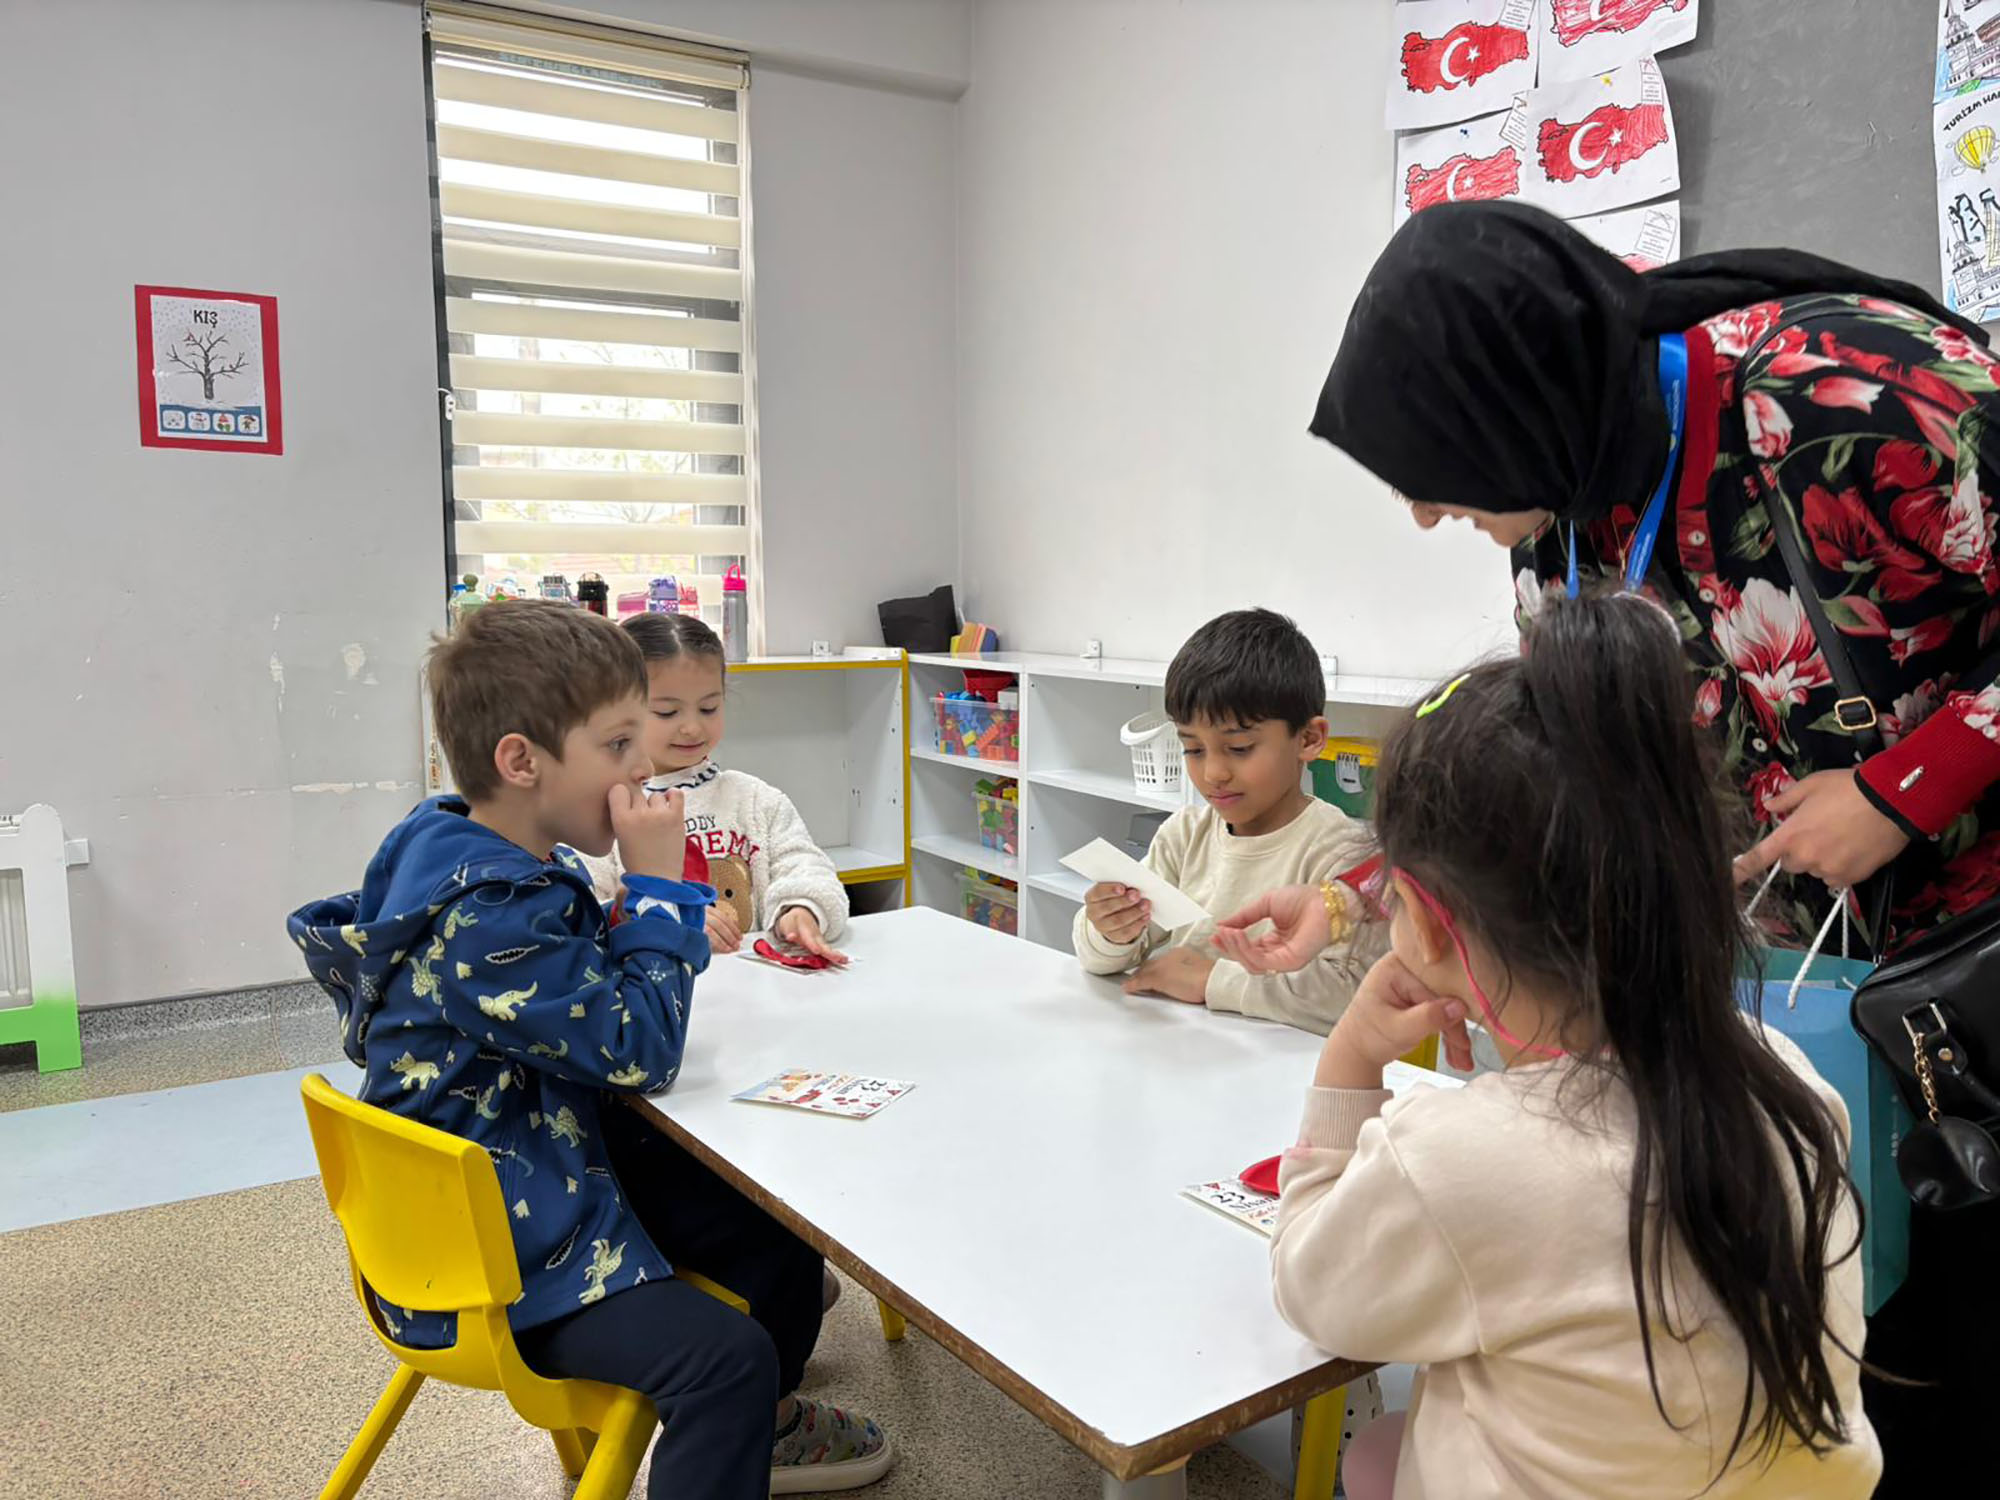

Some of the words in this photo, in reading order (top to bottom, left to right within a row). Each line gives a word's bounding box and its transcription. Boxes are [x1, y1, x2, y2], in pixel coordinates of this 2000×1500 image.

[1982, 91, 2000, 104] HA
[193, 309, 218, 328] KIŞ
[684, 815, 715, 832] DDY
